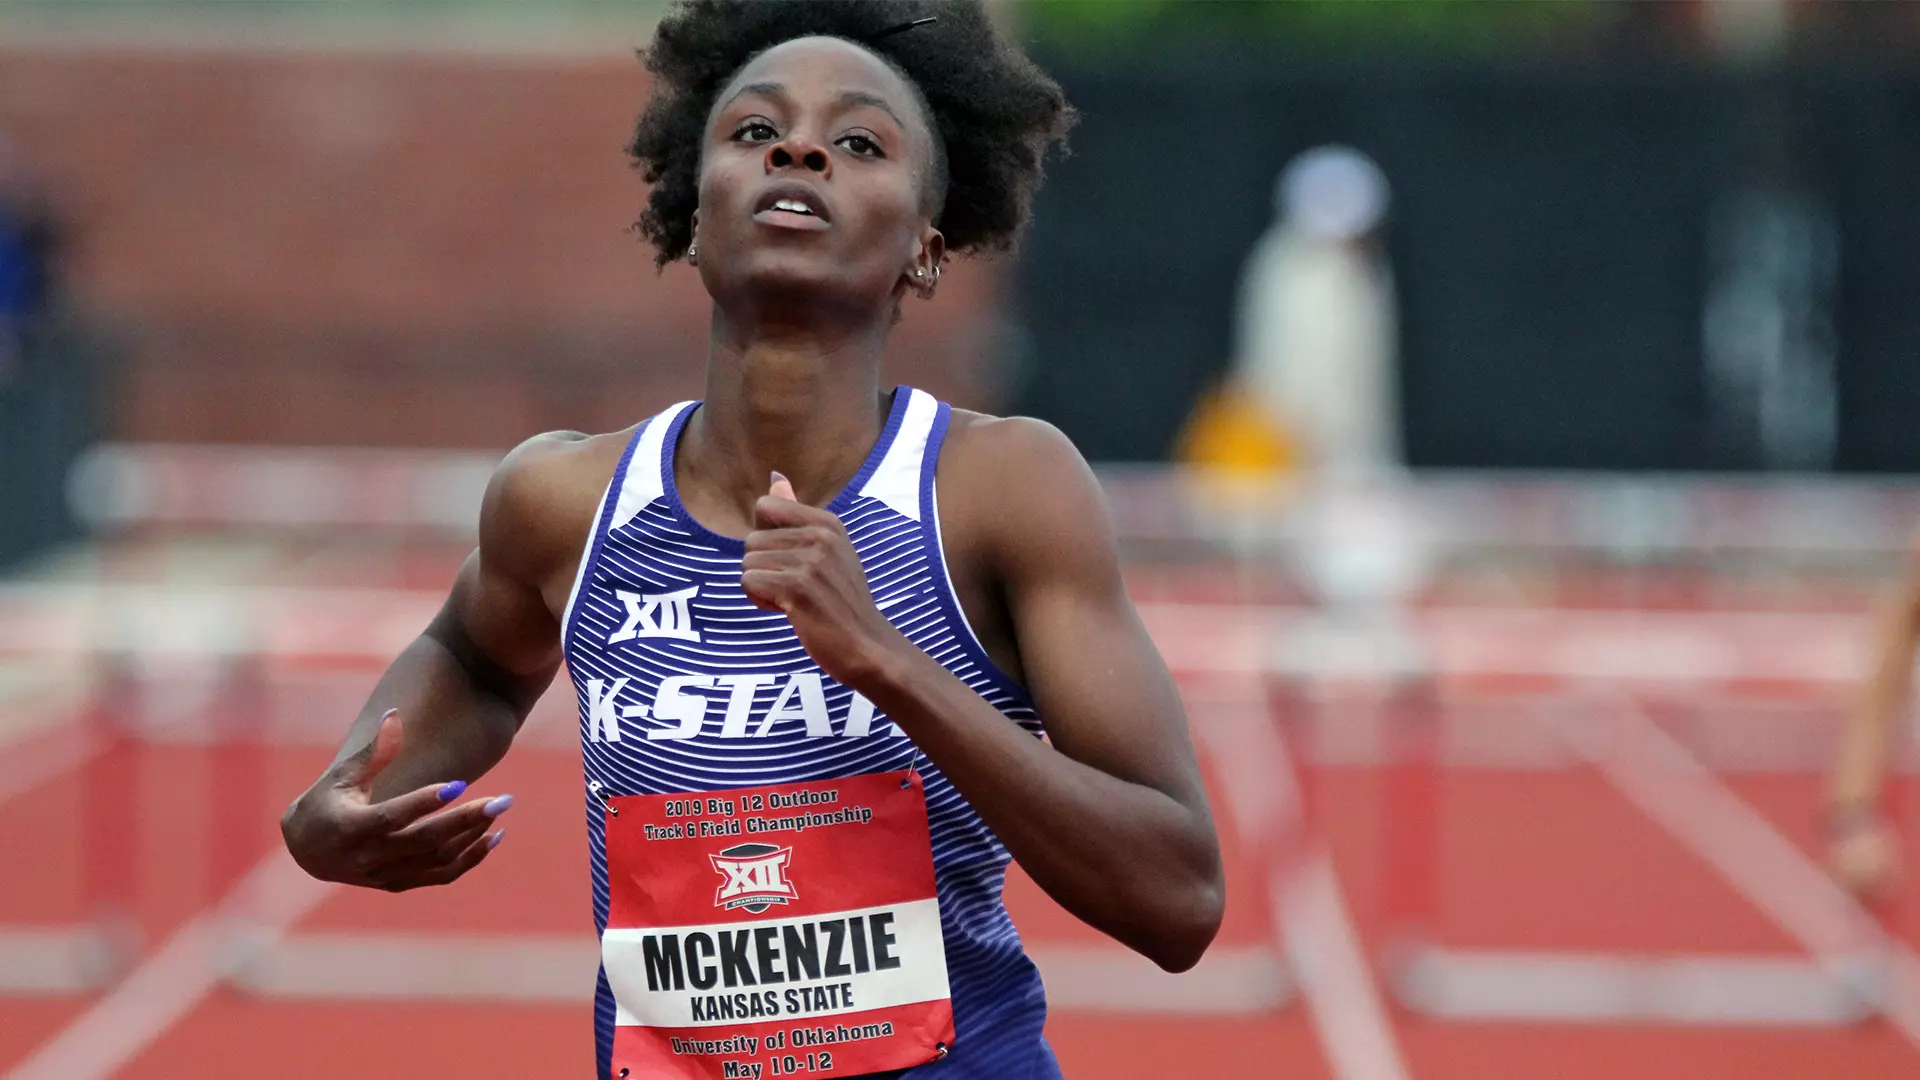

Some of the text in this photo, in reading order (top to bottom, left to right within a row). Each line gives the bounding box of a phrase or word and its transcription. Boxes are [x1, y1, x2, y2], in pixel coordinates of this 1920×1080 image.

[607, 585, 701, 645] XII
[587, 672, 908, 742] K-STA
[665, 789, 838, 817] 2019 Big 12 Outdoor
[644, 806, 873, 840] Track & Field Championship
[719, 857, 792, 899] XII
[642, 912, 900, 992] MCKENZIE
[691, 983, 854, 1021] KANSAS STATE
[670, 1021, 894, 1055] University of Oklahoma
[723, 1052, 833, 1080] May 10-12
